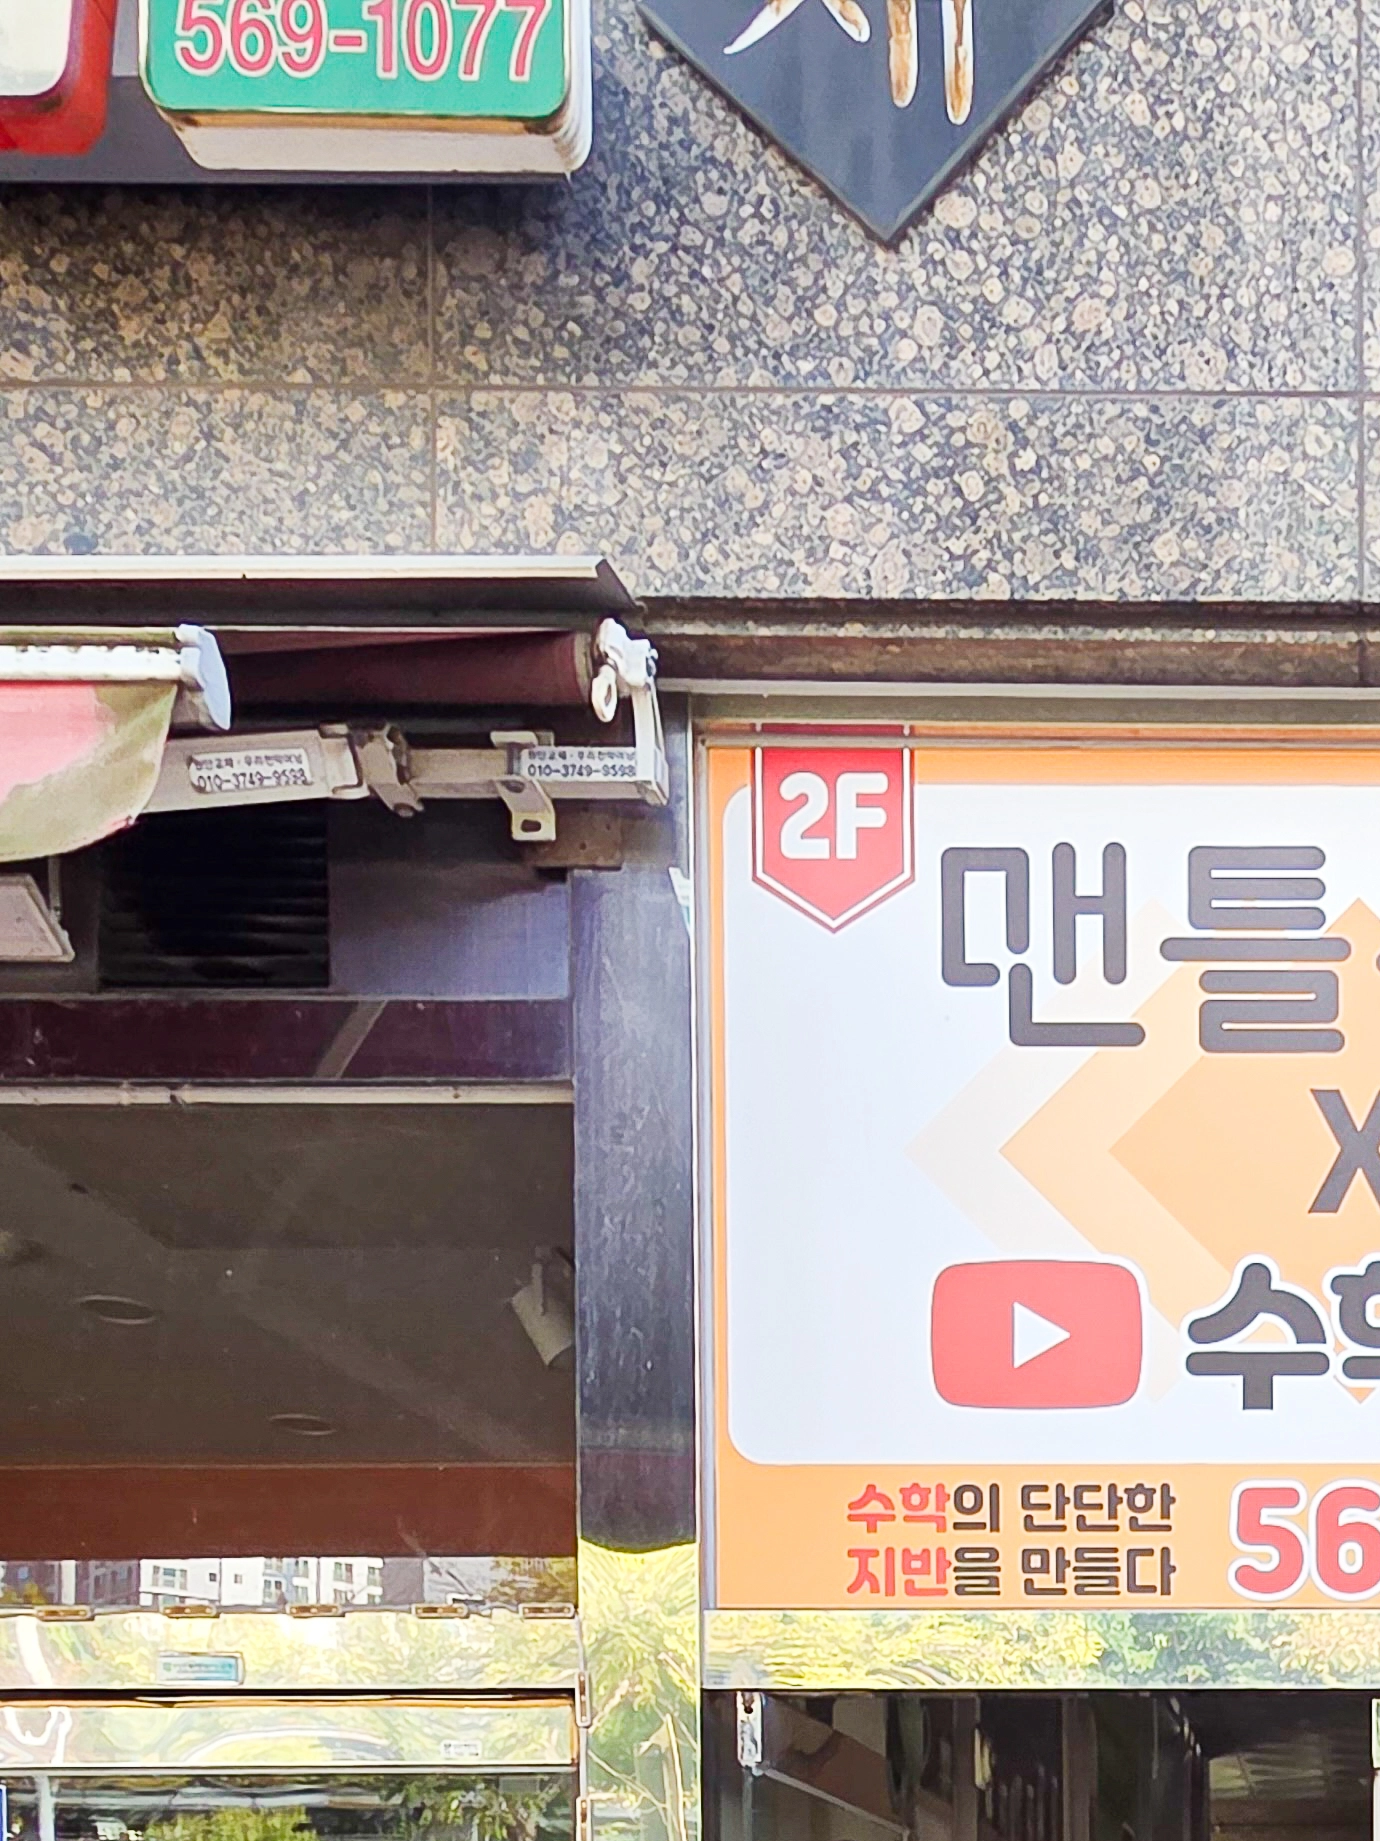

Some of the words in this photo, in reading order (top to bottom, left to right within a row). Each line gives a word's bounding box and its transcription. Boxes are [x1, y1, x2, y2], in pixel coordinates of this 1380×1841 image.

[175, 0, 552, 82] 569-1077
[778, 772, 889, 860] 2F
[846, 1482, 1000, 1534] 수학의
[1020, 1482, 1177, 1534] 단단한
[846, 1545, 1000, 1597] 지반을
[1020, 1545, 1177, 1597] 만들다
